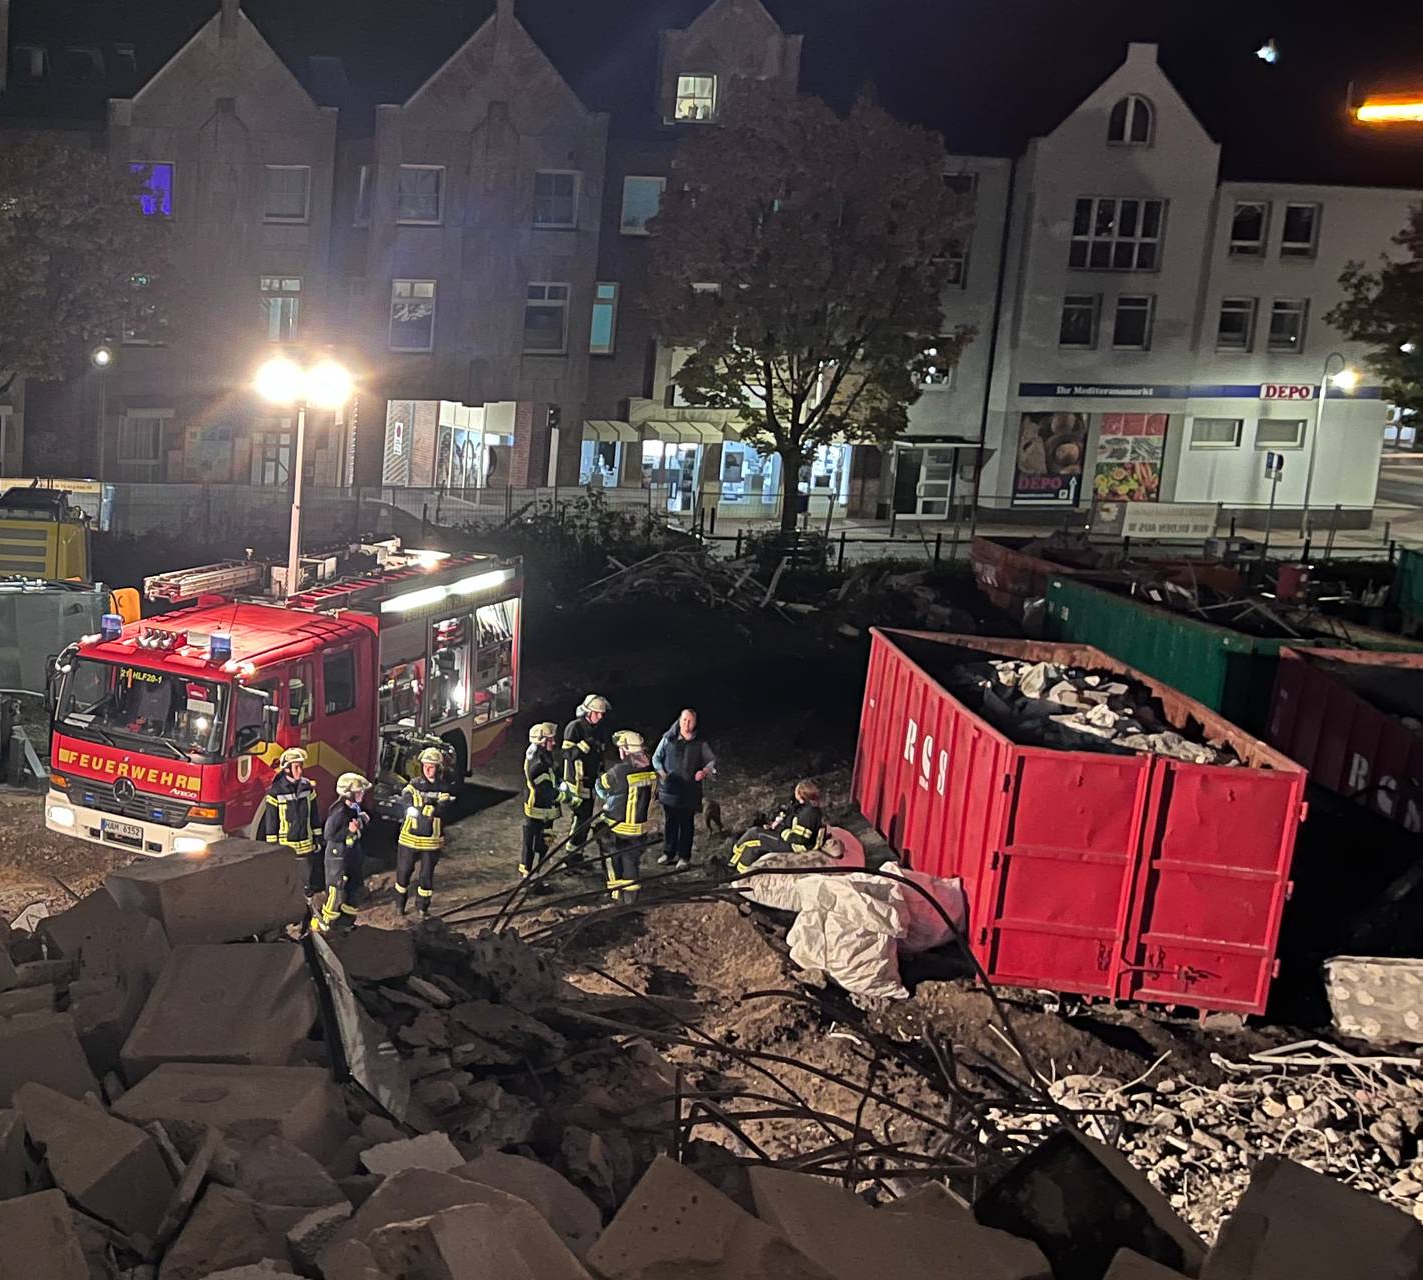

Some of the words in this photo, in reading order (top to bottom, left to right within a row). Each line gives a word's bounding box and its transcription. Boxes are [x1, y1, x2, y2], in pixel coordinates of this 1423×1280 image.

[1056, 386, 1072, 395] Ihr
[1265, 385, 1310, 399] DEPO
[1018, 477, 1062, 489] DEPO
[68, 751, 189, 789] FEUERWEHR
